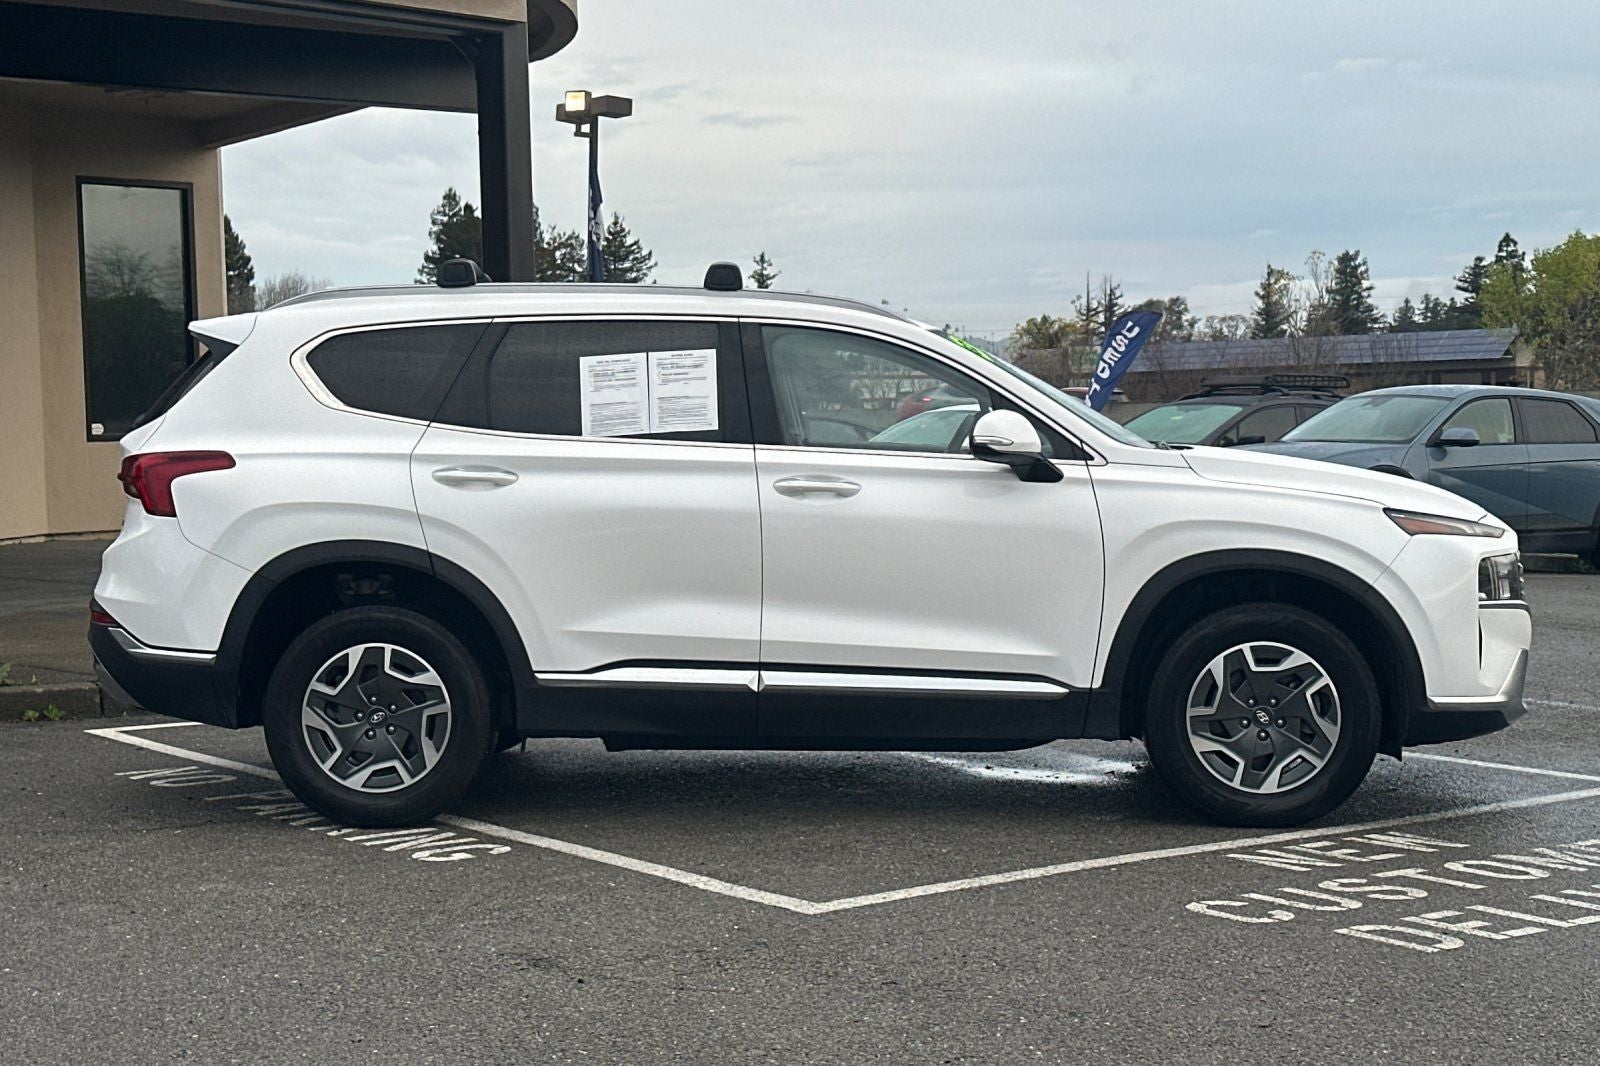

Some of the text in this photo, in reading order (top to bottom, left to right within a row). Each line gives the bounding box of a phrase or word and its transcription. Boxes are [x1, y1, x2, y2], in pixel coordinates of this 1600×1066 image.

[1096, 321, 1140, 379] USED
[114, 766, 237, 787] NO
[1225, 832, 1471, 872] NEW
